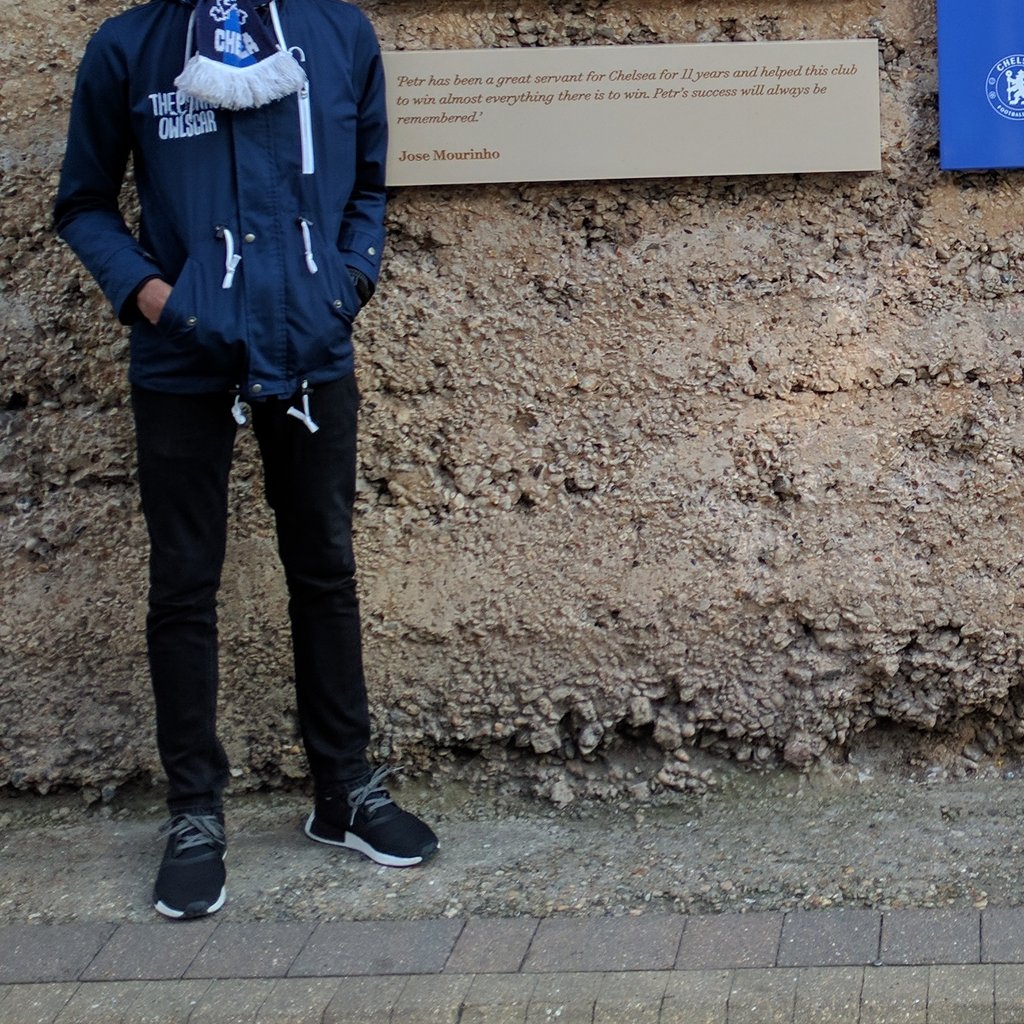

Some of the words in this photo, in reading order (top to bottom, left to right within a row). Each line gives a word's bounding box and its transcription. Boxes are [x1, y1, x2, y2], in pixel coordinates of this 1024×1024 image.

[429, 74, 451, 85] has
[454, 73, 484, 84] been
[495, 72, 532, 86] great
[535, 71, 584, 83] servant
[586, 70, 606, 82] for
[609, 69, 657, 81] Chelsea
[659, 69, 678, 80] for
[681, 68, 692, 80] 11
[692, 71, 730, 82] years
[733, 67, 758, 78] and
[761, 66, 802, 81] helped
[805, 66, 828, 77] this
[831, 65, 857, 76] club
[397, 94, 410, 105] to
[412, 93, 437, 104] win
[439, 92, 483, 104] almost
[486, 90, 554, 106] everything
[558, 89, 591, 101] there
[594, 89, 605, 100] is
[608, 89, 621, 100] to
[624, 88, 650, 99] win.
[654, 87, 688, 99] Petr's
[692, 89, 737, 98] success
[740, 85, 764, 97] will
[767, 84, 810, 99] always
[813, 84, 827, 95] be
[399, 150, 430, 161] Jose
[433, 149, 500, 160] Mourinho
